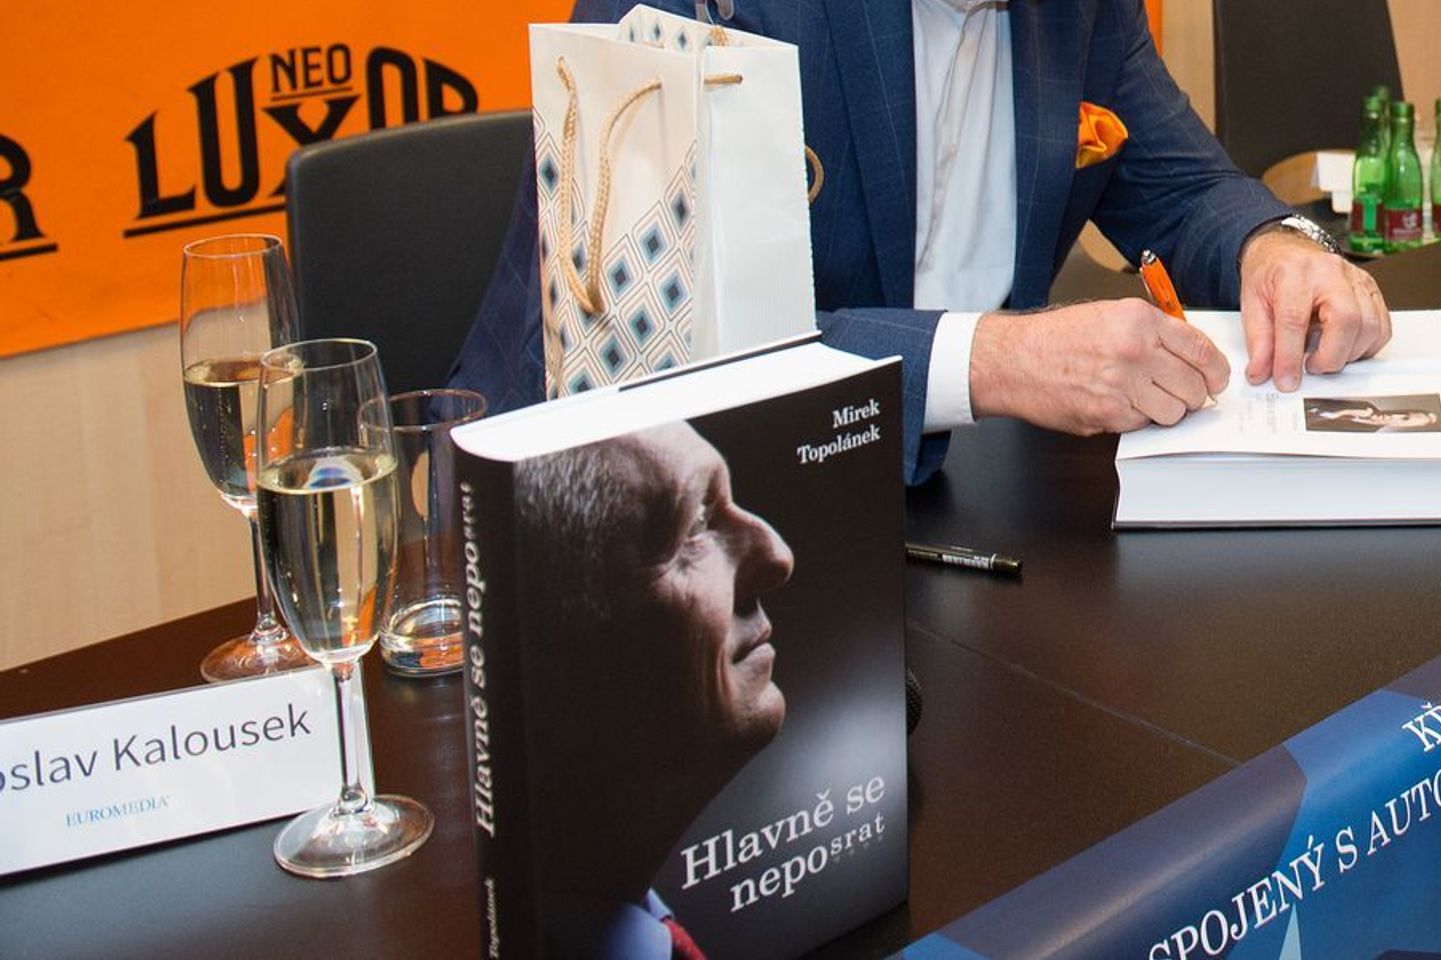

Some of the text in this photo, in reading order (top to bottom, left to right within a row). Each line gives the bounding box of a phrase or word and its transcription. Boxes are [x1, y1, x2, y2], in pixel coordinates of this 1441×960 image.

[269, 43, 353, 94] NEO
[832, 398, 880, 429] Mirek
[796, 423, 881, 464] Topolánek
[0, 702, 313, 792] slav Kalousek
[680, 774, 886, 891] Hlavně se
[1335, 826, 1358, 874] S
